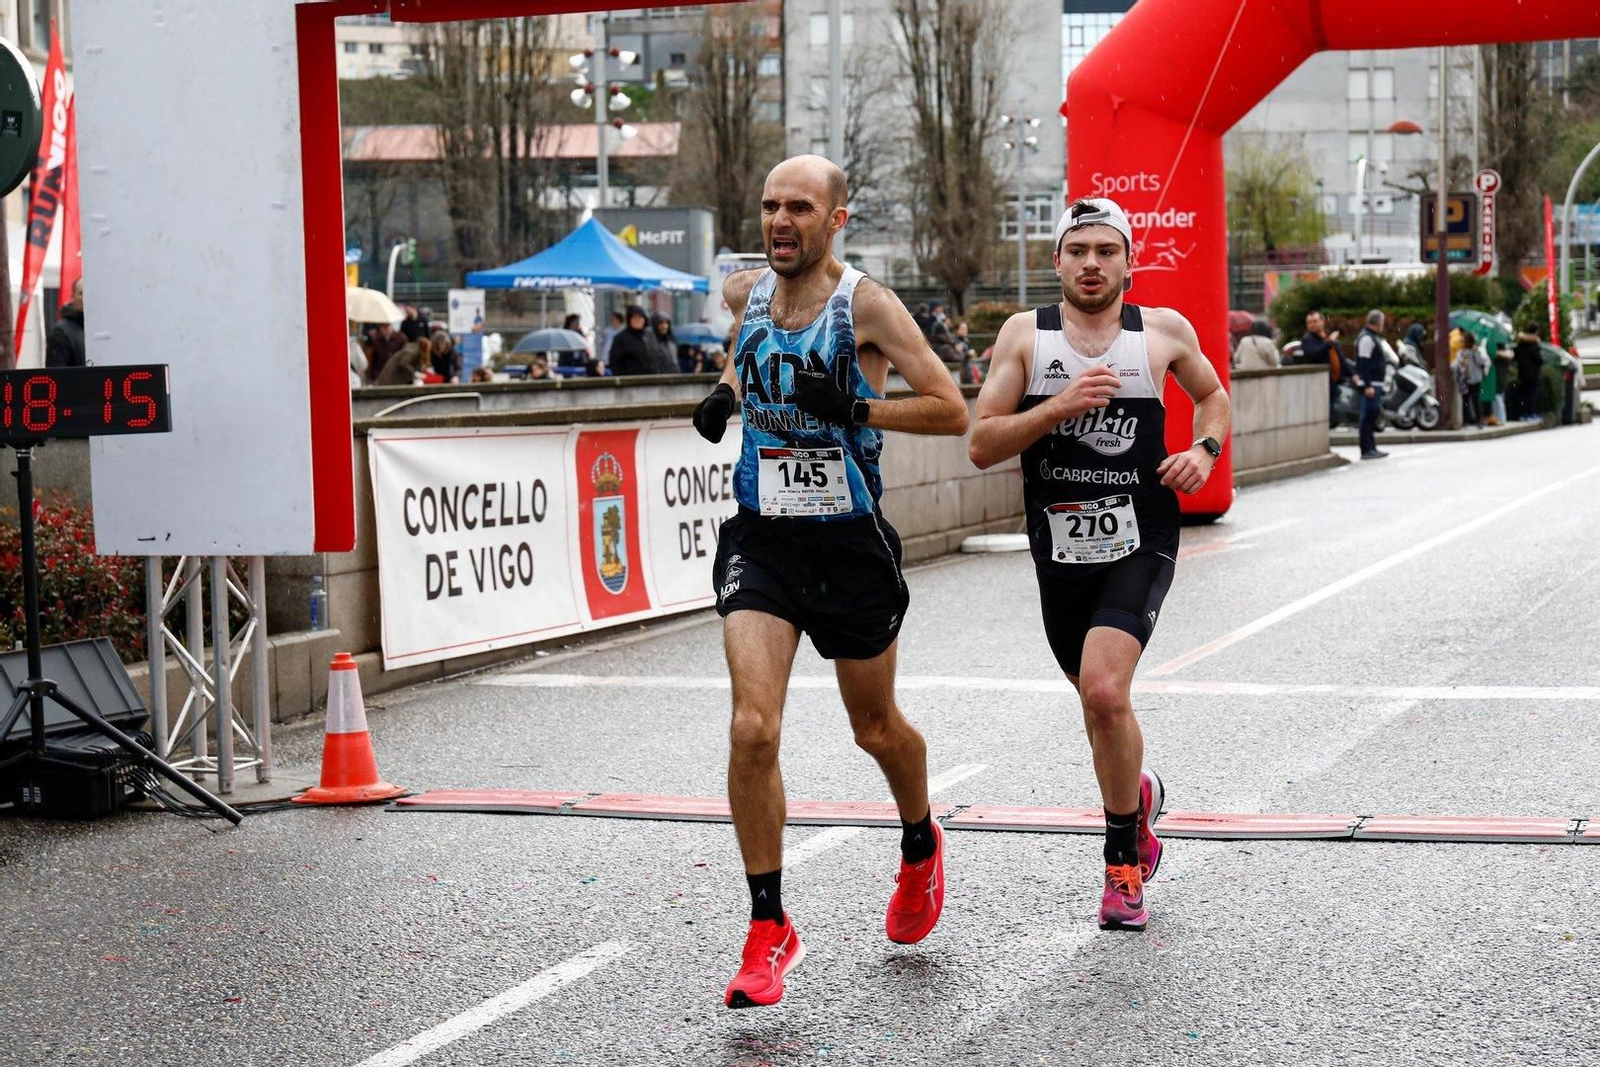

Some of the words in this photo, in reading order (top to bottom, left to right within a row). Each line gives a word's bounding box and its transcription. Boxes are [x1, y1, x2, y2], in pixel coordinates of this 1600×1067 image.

[1091, 171, 1161, 198] Sports
[1481, 174, 1496, 191] P
[1123, 207, 1197, 229] tander
[638, 230, 685, 244] McFIT
[1048, 406, 1139, 438] elikia
[1095, 437, 1121, 448] fresh
[778, 461, 828, 488] 145
[403, 478, 547, 537] CONCELLO
[1065, 512, 1119, 539] 270
[678, 519, 707, 561] DE
[426, 551, 463, 601] DE
[468, 541, 534, 595] VIGO
